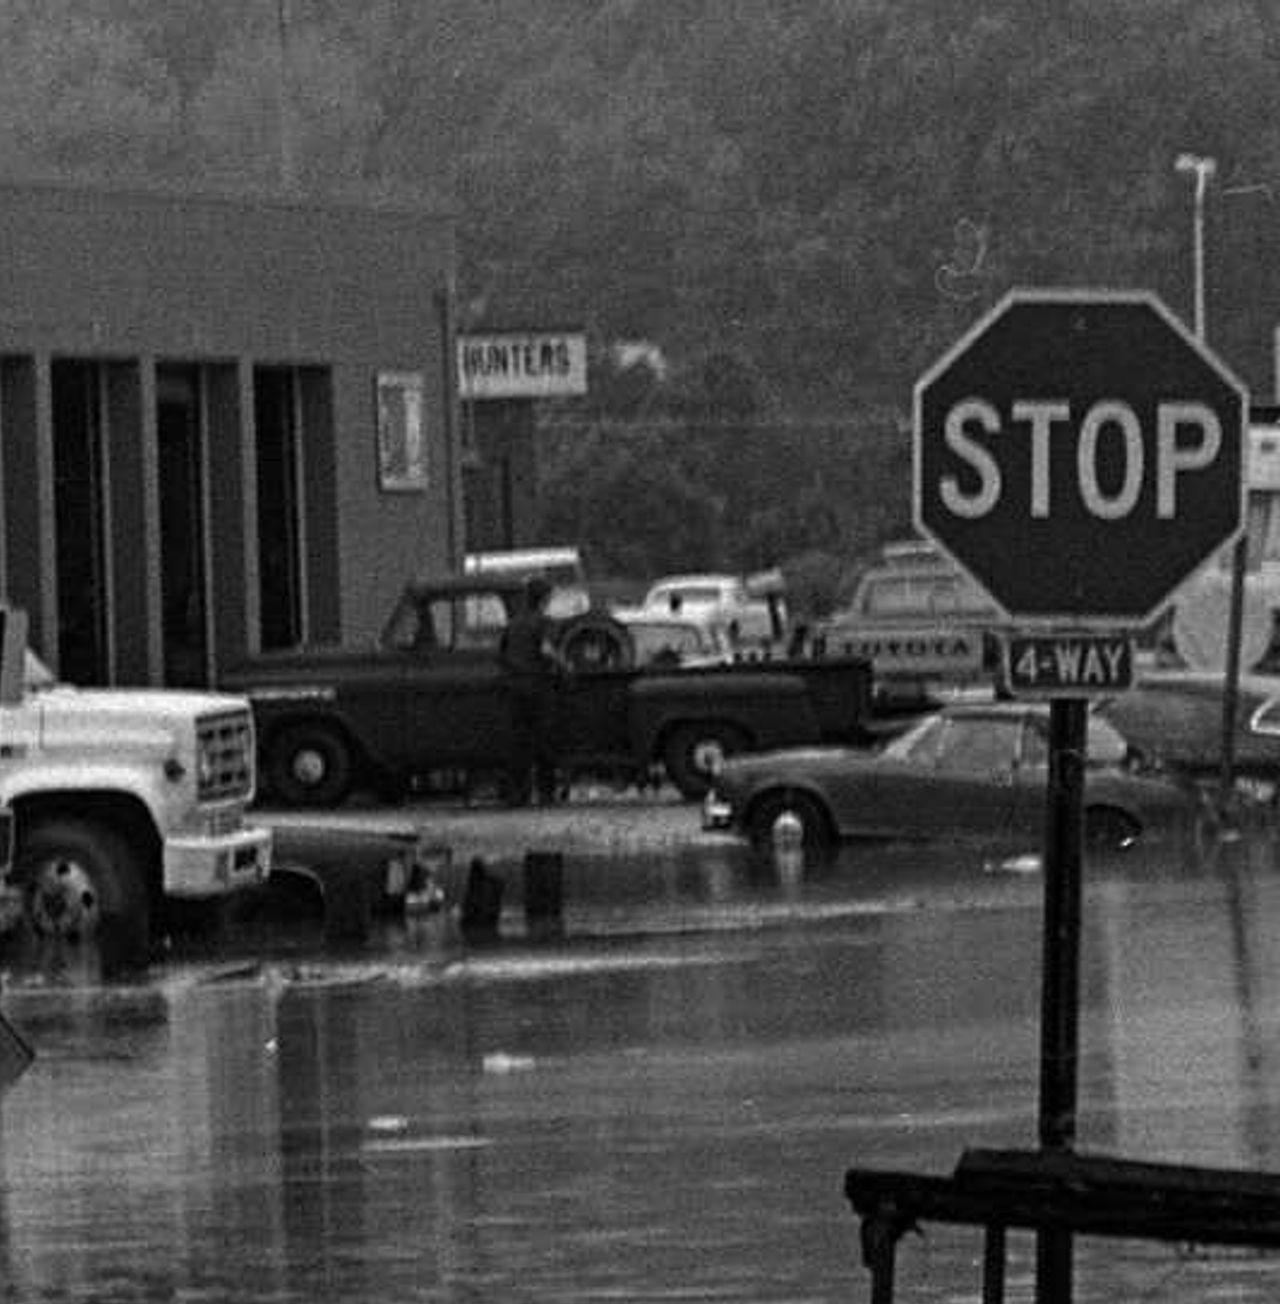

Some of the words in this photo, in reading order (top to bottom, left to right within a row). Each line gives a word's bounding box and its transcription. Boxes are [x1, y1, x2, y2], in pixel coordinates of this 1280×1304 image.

[940, 398, 1223, 519] STOP
[841, 639, 970, 656] TOYOTA
[1015, 644, 1123, 684] 4-WAY
